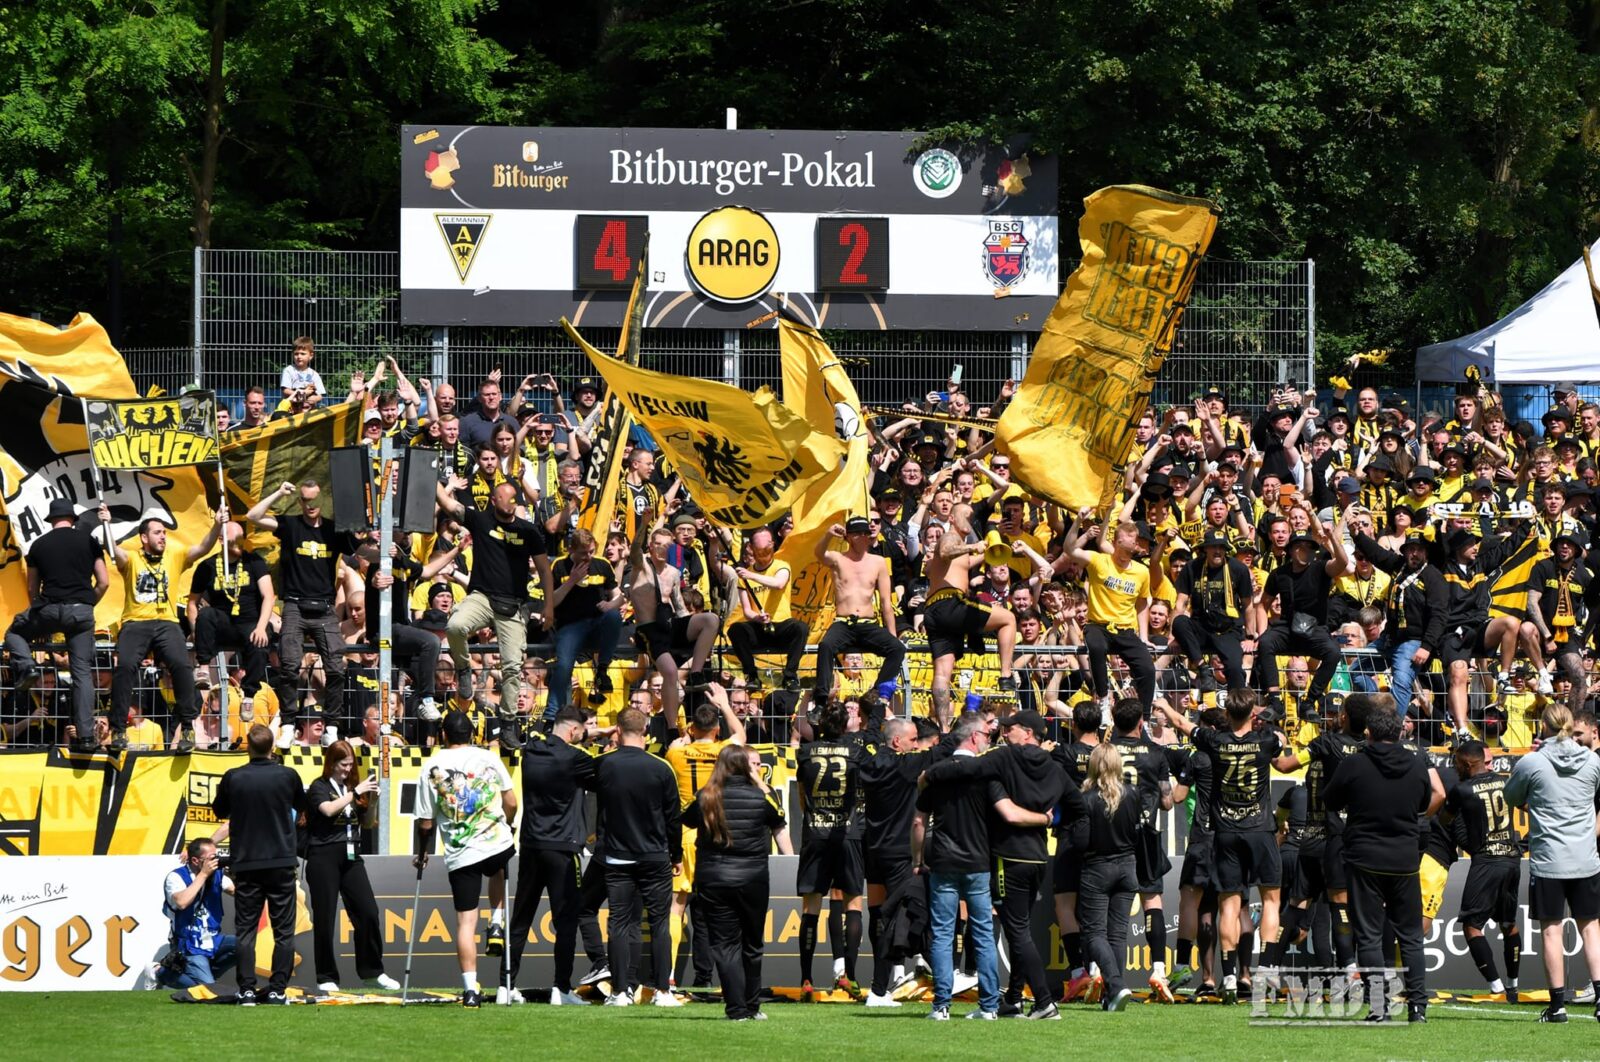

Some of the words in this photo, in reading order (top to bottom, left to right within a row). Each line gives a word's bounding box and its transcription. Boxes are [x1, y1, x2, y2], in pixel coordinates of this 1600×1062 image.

[493, 165, 569, 192] Bitburger
[609, 148, 876, 196] Bitburger-Pokal
[994, 222, 1019, 232] BSC
[594, 220, 631, 281] 4
[698, 238, 769, 267] ARAG
[839, 223, 869, 283] 2
[627, 391, 709, 422] YELLOW
[94, 430, 215, 468] AACHEN
[810, 747, 849, 757] ALEMANNIA
[1116, 745, 1149, 753] EMANNIA
[1219, 744, 1261, 752] ALEMANNIA
[811, 756, 847, 797] 23
[1479, 790, 1510, 831] 19
